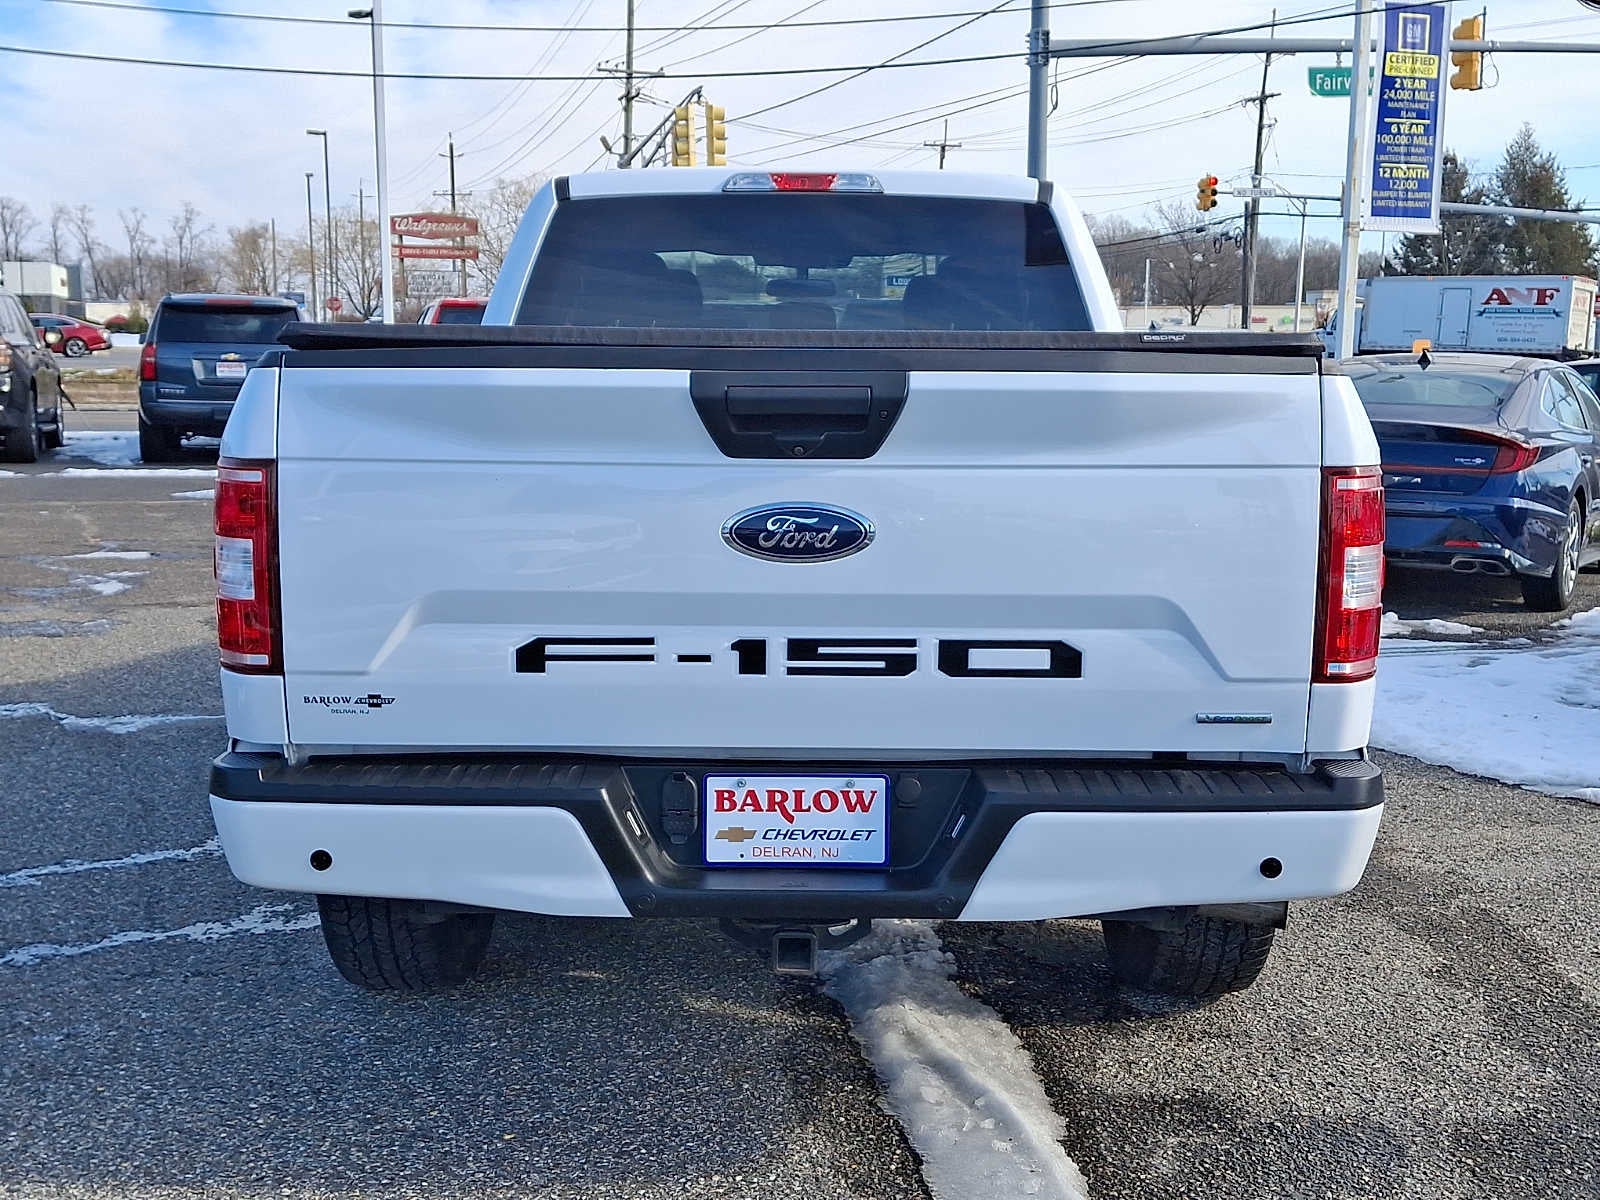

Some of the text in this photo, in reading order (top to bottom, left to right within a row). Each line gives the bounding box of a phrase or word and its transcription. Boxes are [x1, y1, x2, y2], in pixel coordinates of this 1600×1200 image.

[1406, 23, 1421, 38] GM
[1389, 54, 1436, 65] CERTIFIED
[1388, 65, 1434, 76] PRE-OWNED
[1316, 73, 1374, 91] Fairv
[1394, 77, 1428, 90] 2 YEAR
[1383, 88, 1436, 102] 24,000 MILE
[1390, 123, 1425, 135] 6 YEAR
[1376, 134, 1435, 146] 100,000 MILE
[1378, 168, 1430, 179] 12 MONTH
[393, 216, 468, 235] Walgreens
[1481, 287, 1560, 306] ANF
[758, 514, 840, 549] Ford
[515, 636, 1083, 678] F-150
[303, 695, 352, 707] BARLOW
[714, 789, 878, 825] BARLOW
[761, 828, 877, 841] CHEVROLET
[752, 846, 840, 860] DELRAN, NJ
